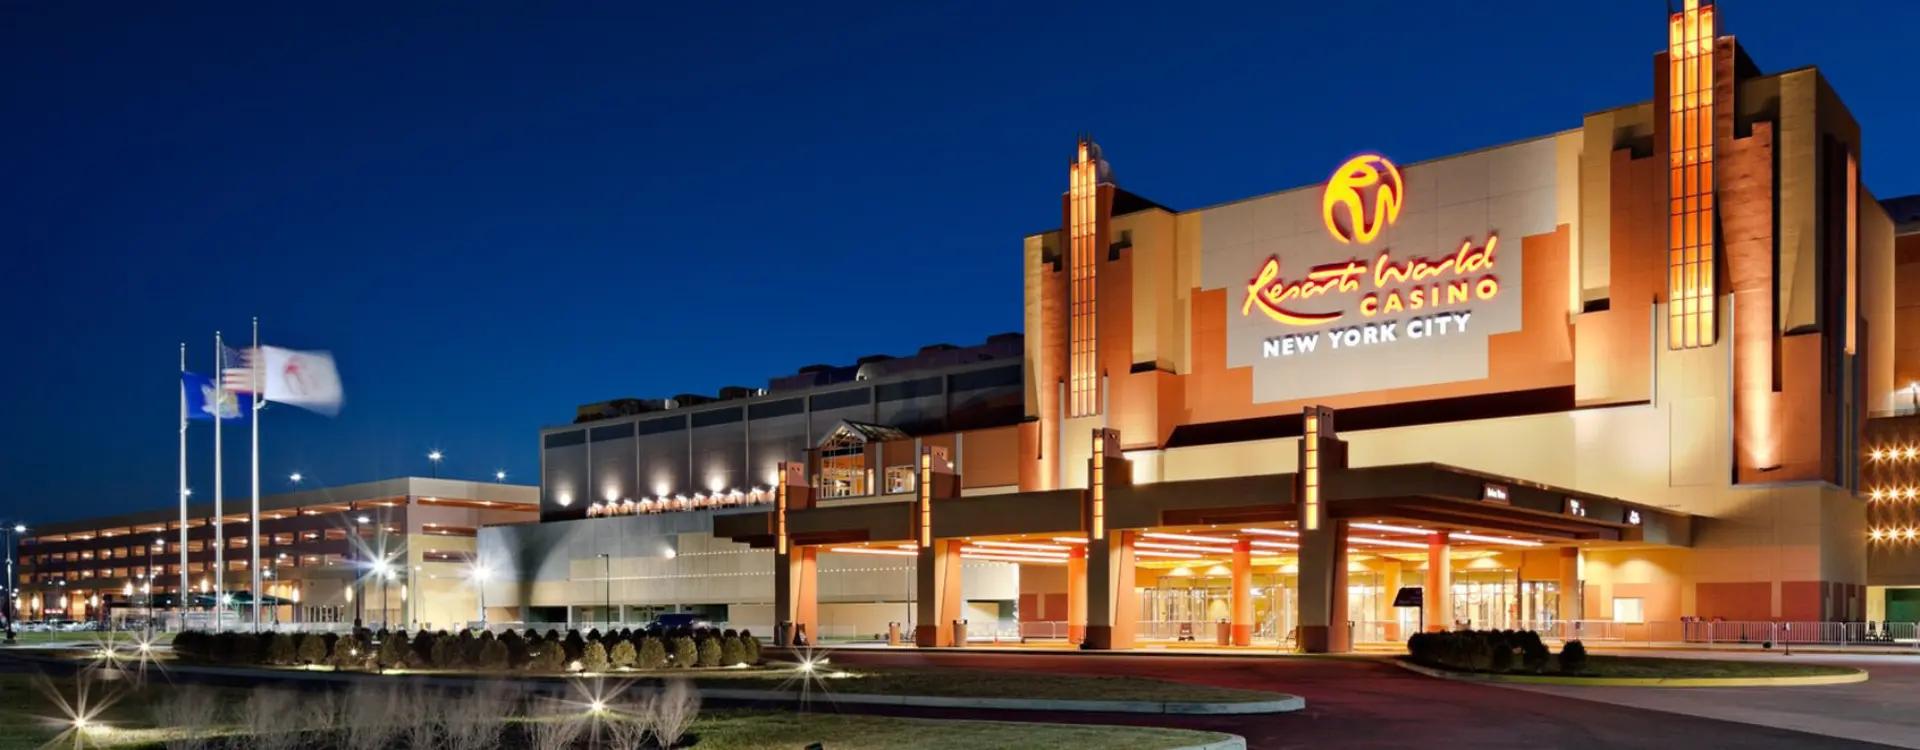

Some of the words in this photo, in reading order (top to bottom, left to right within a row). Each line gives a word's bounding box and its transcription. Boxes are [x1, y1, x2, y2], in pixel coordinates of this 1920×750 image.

[1242, 259, 1368, 326] Resorts
[1374, 235, 1498, 288] World
[1359, 278, 1499, 317] CASINO
[1263, 335, 1319, 358] NEW
[1327, 324, 1397, 349] YORK
[1406, 313, 1472, 338] CITY
